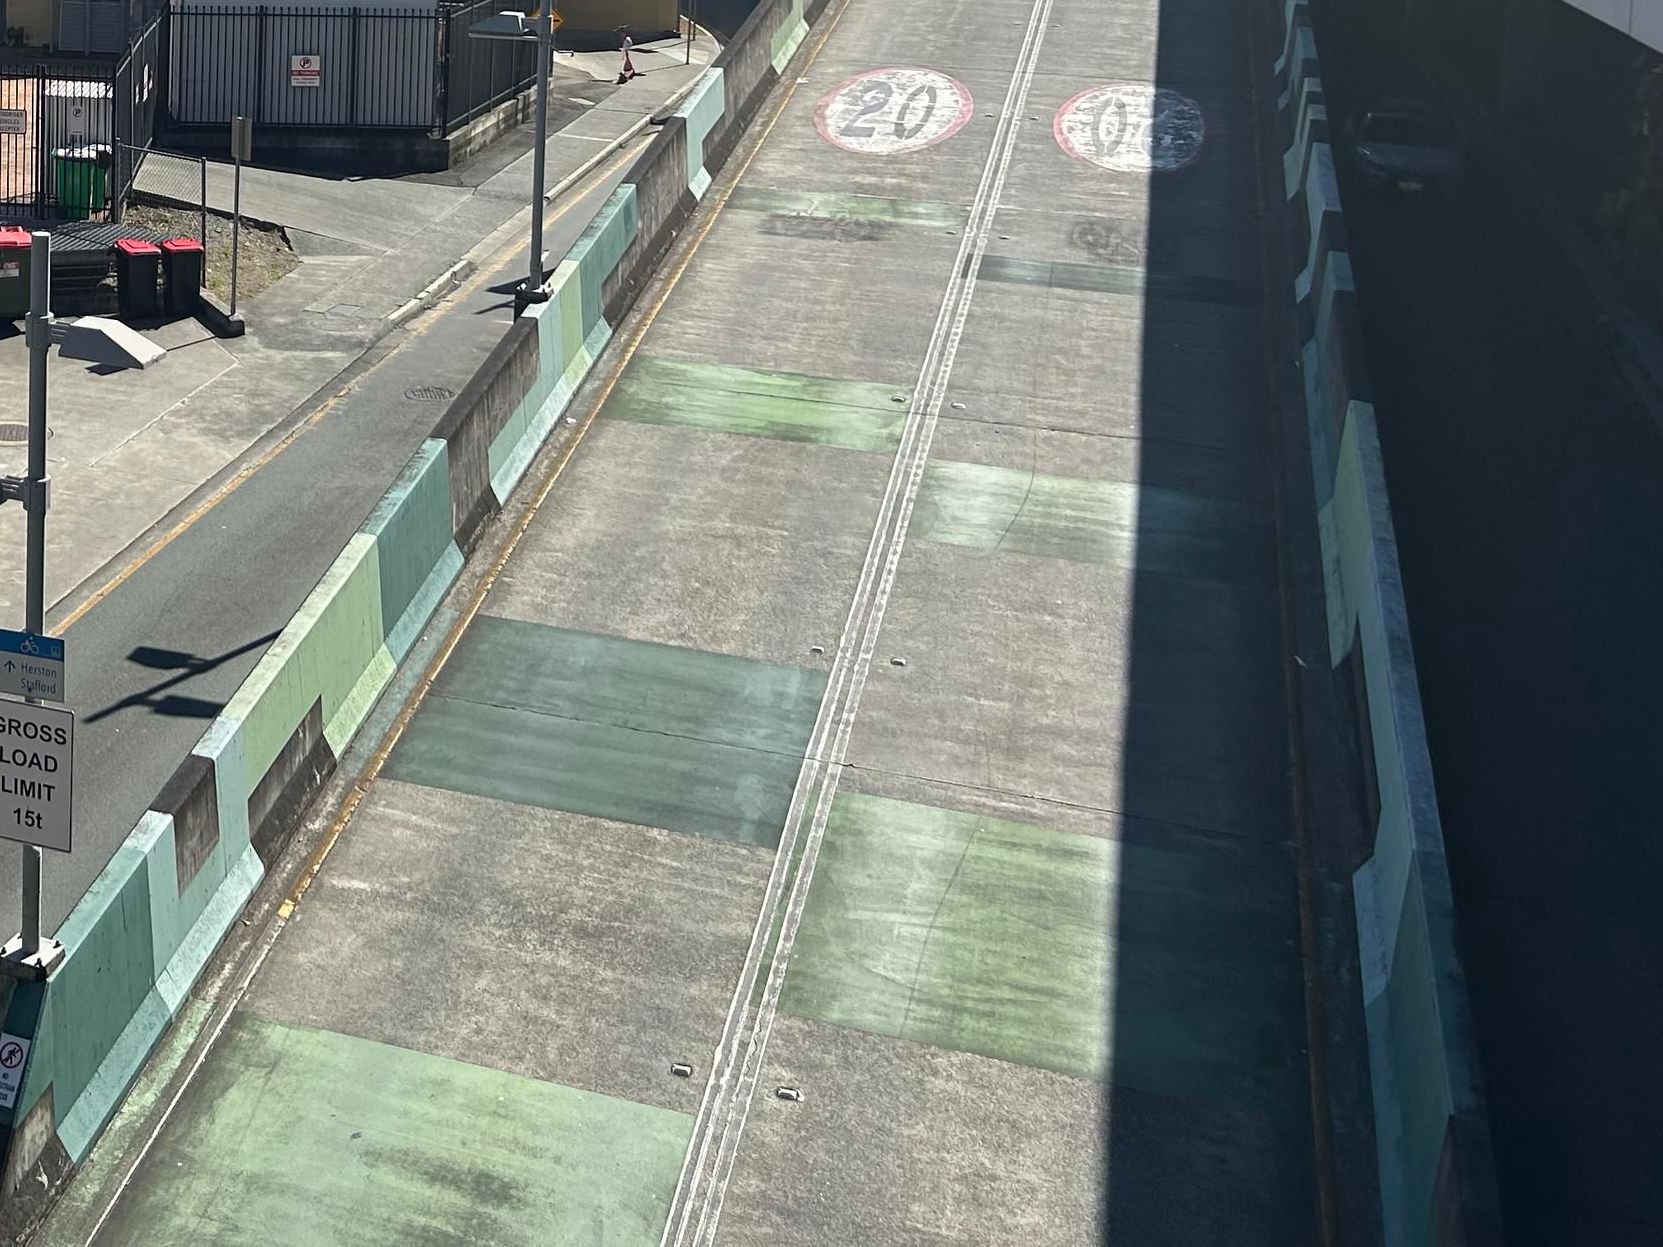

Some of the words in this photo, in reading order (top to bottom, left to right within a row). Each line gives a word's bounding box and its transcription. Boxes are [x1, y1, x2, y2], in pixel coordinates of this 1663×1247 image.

[839, 79, 938, 141] 20
[21, 661, 58, 679] Herston
[20, 677, 57, 695] Stafford
[0, 745, 59, 773] LOAD
[1, 774, 56, 802] LIMIT
[12, 806, 44, 830] 15t
